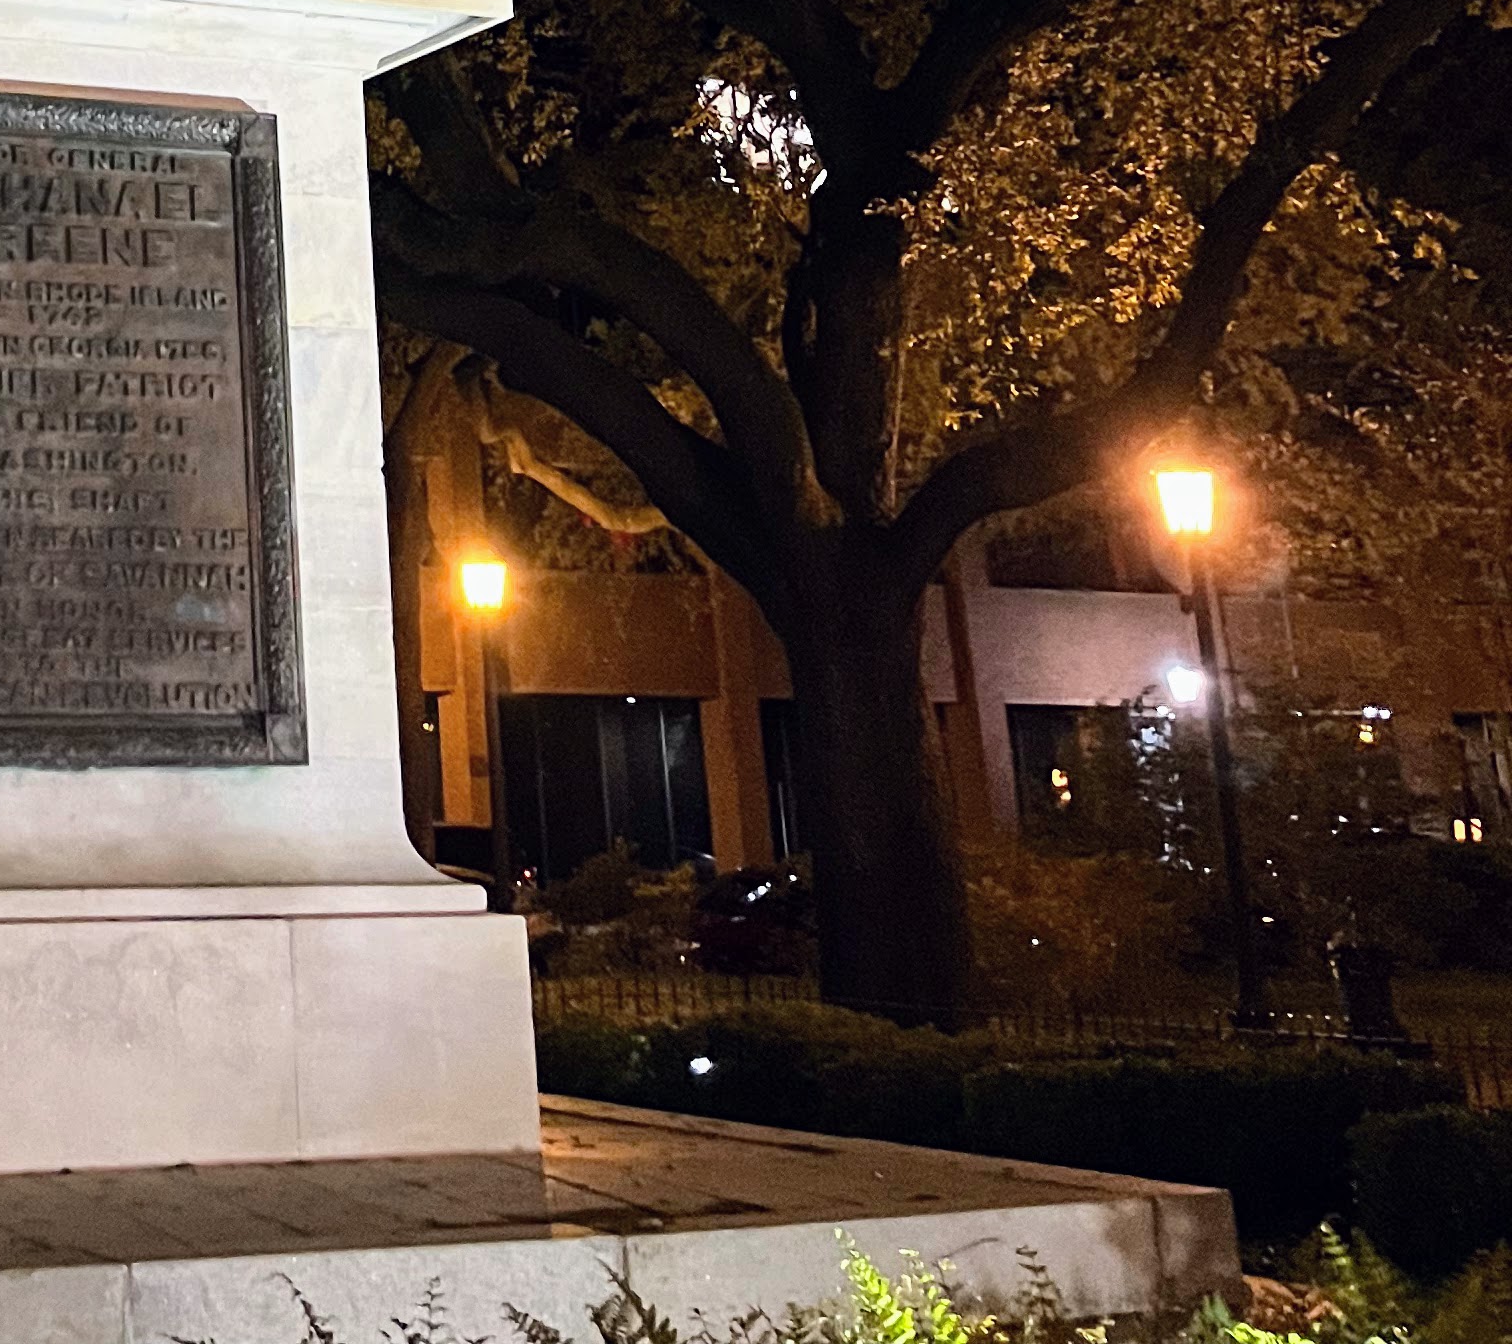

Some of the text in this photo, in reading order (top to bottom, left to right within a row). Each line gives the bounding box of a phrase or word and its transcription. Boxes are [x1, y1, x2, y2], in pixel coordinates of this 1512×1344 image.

[46, 146, 188, 176] GENERAL
[23, 279, 122, 308] RHODE
[129, 284, 228, 313] ISLAND
[28, 333, 145, 362] GEORGIA
[14, 409, 139, 436] FRIEND
[153, 415, 192, 439] OF
[193, 526, 246, 554] THE
[27, 562, 71, 591] OF
[85, 562, 247, 595] SAVANNAH
[58, 680, 255, 712] REVOLUTION
